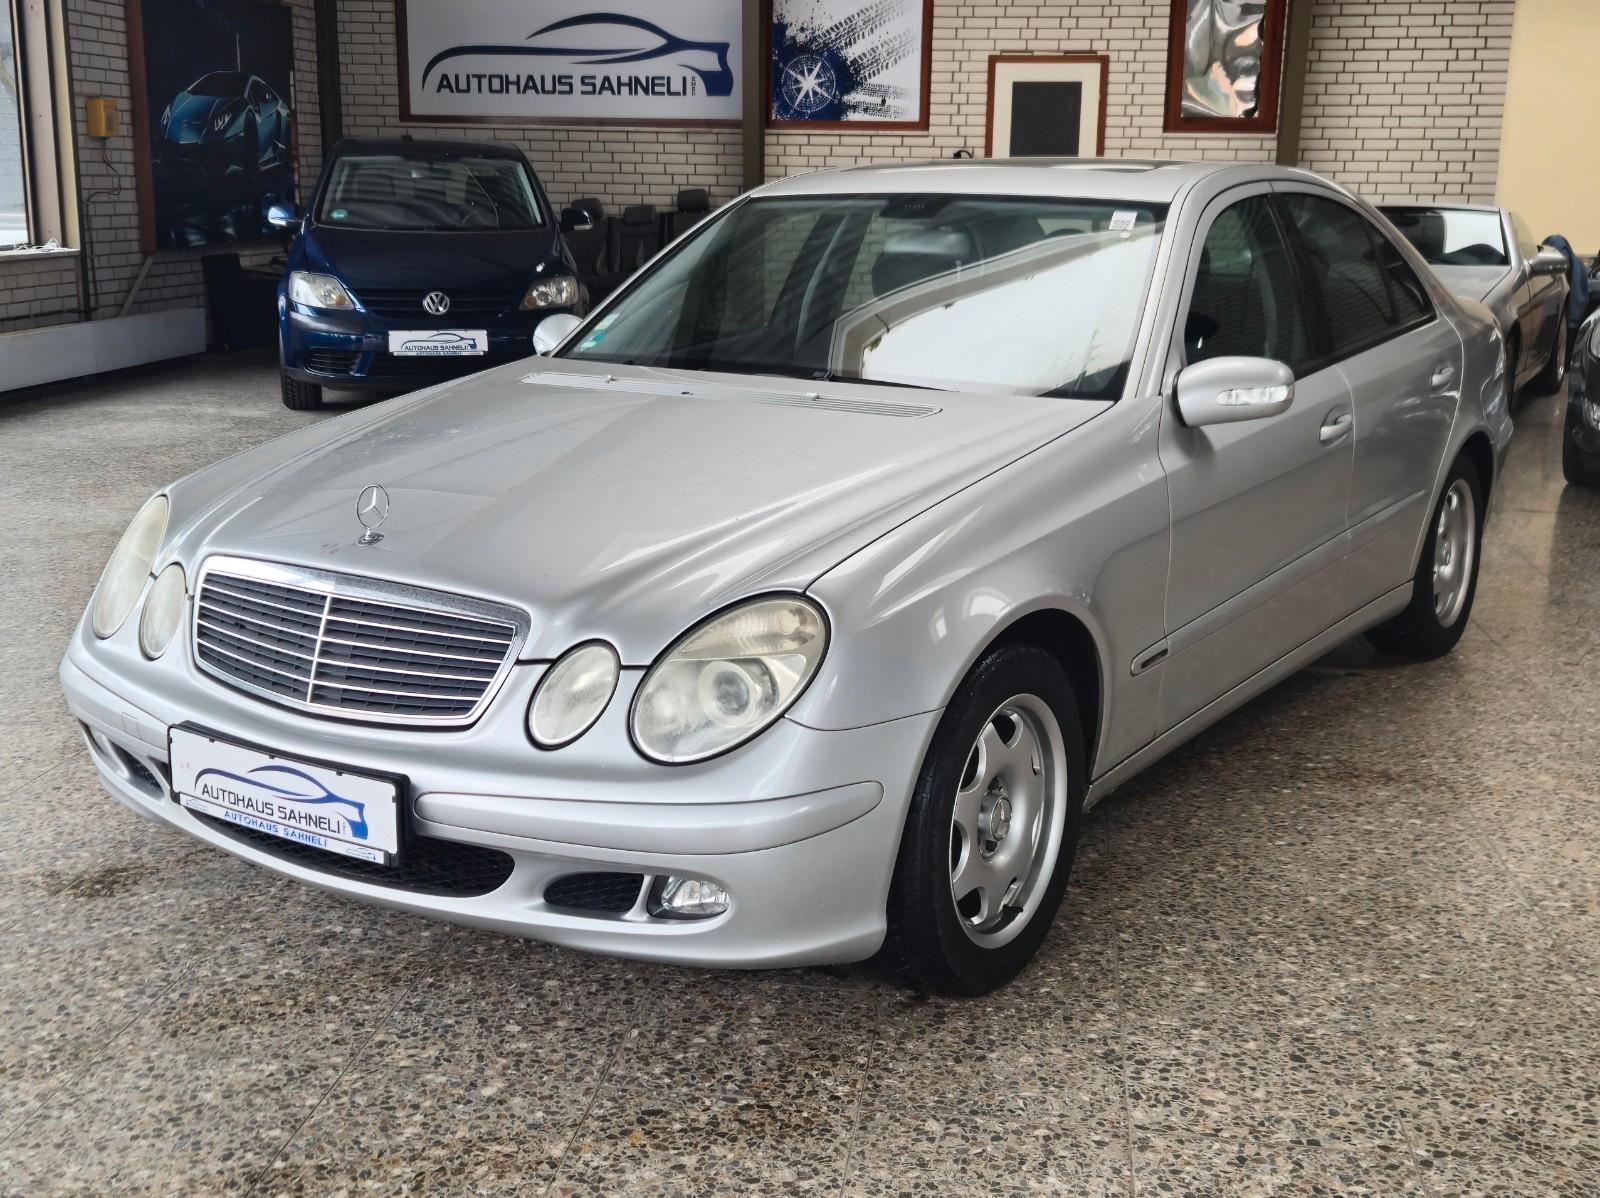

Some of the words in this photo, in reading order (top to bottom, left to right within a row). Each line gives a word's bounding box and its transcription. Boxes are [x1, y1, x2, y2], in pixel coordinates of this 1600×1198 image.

[436, 73, 574, 95] AUTOHAUS
[580, 75, 687, 97] SAHNELI
[201, 783, 274, 817] AUTOHAUS
[278, 806, 341, 835] SAHNELI
[224, 810, 278, 833] AUTOHAUS
[283, 828, 327, 848] SAHNELI
